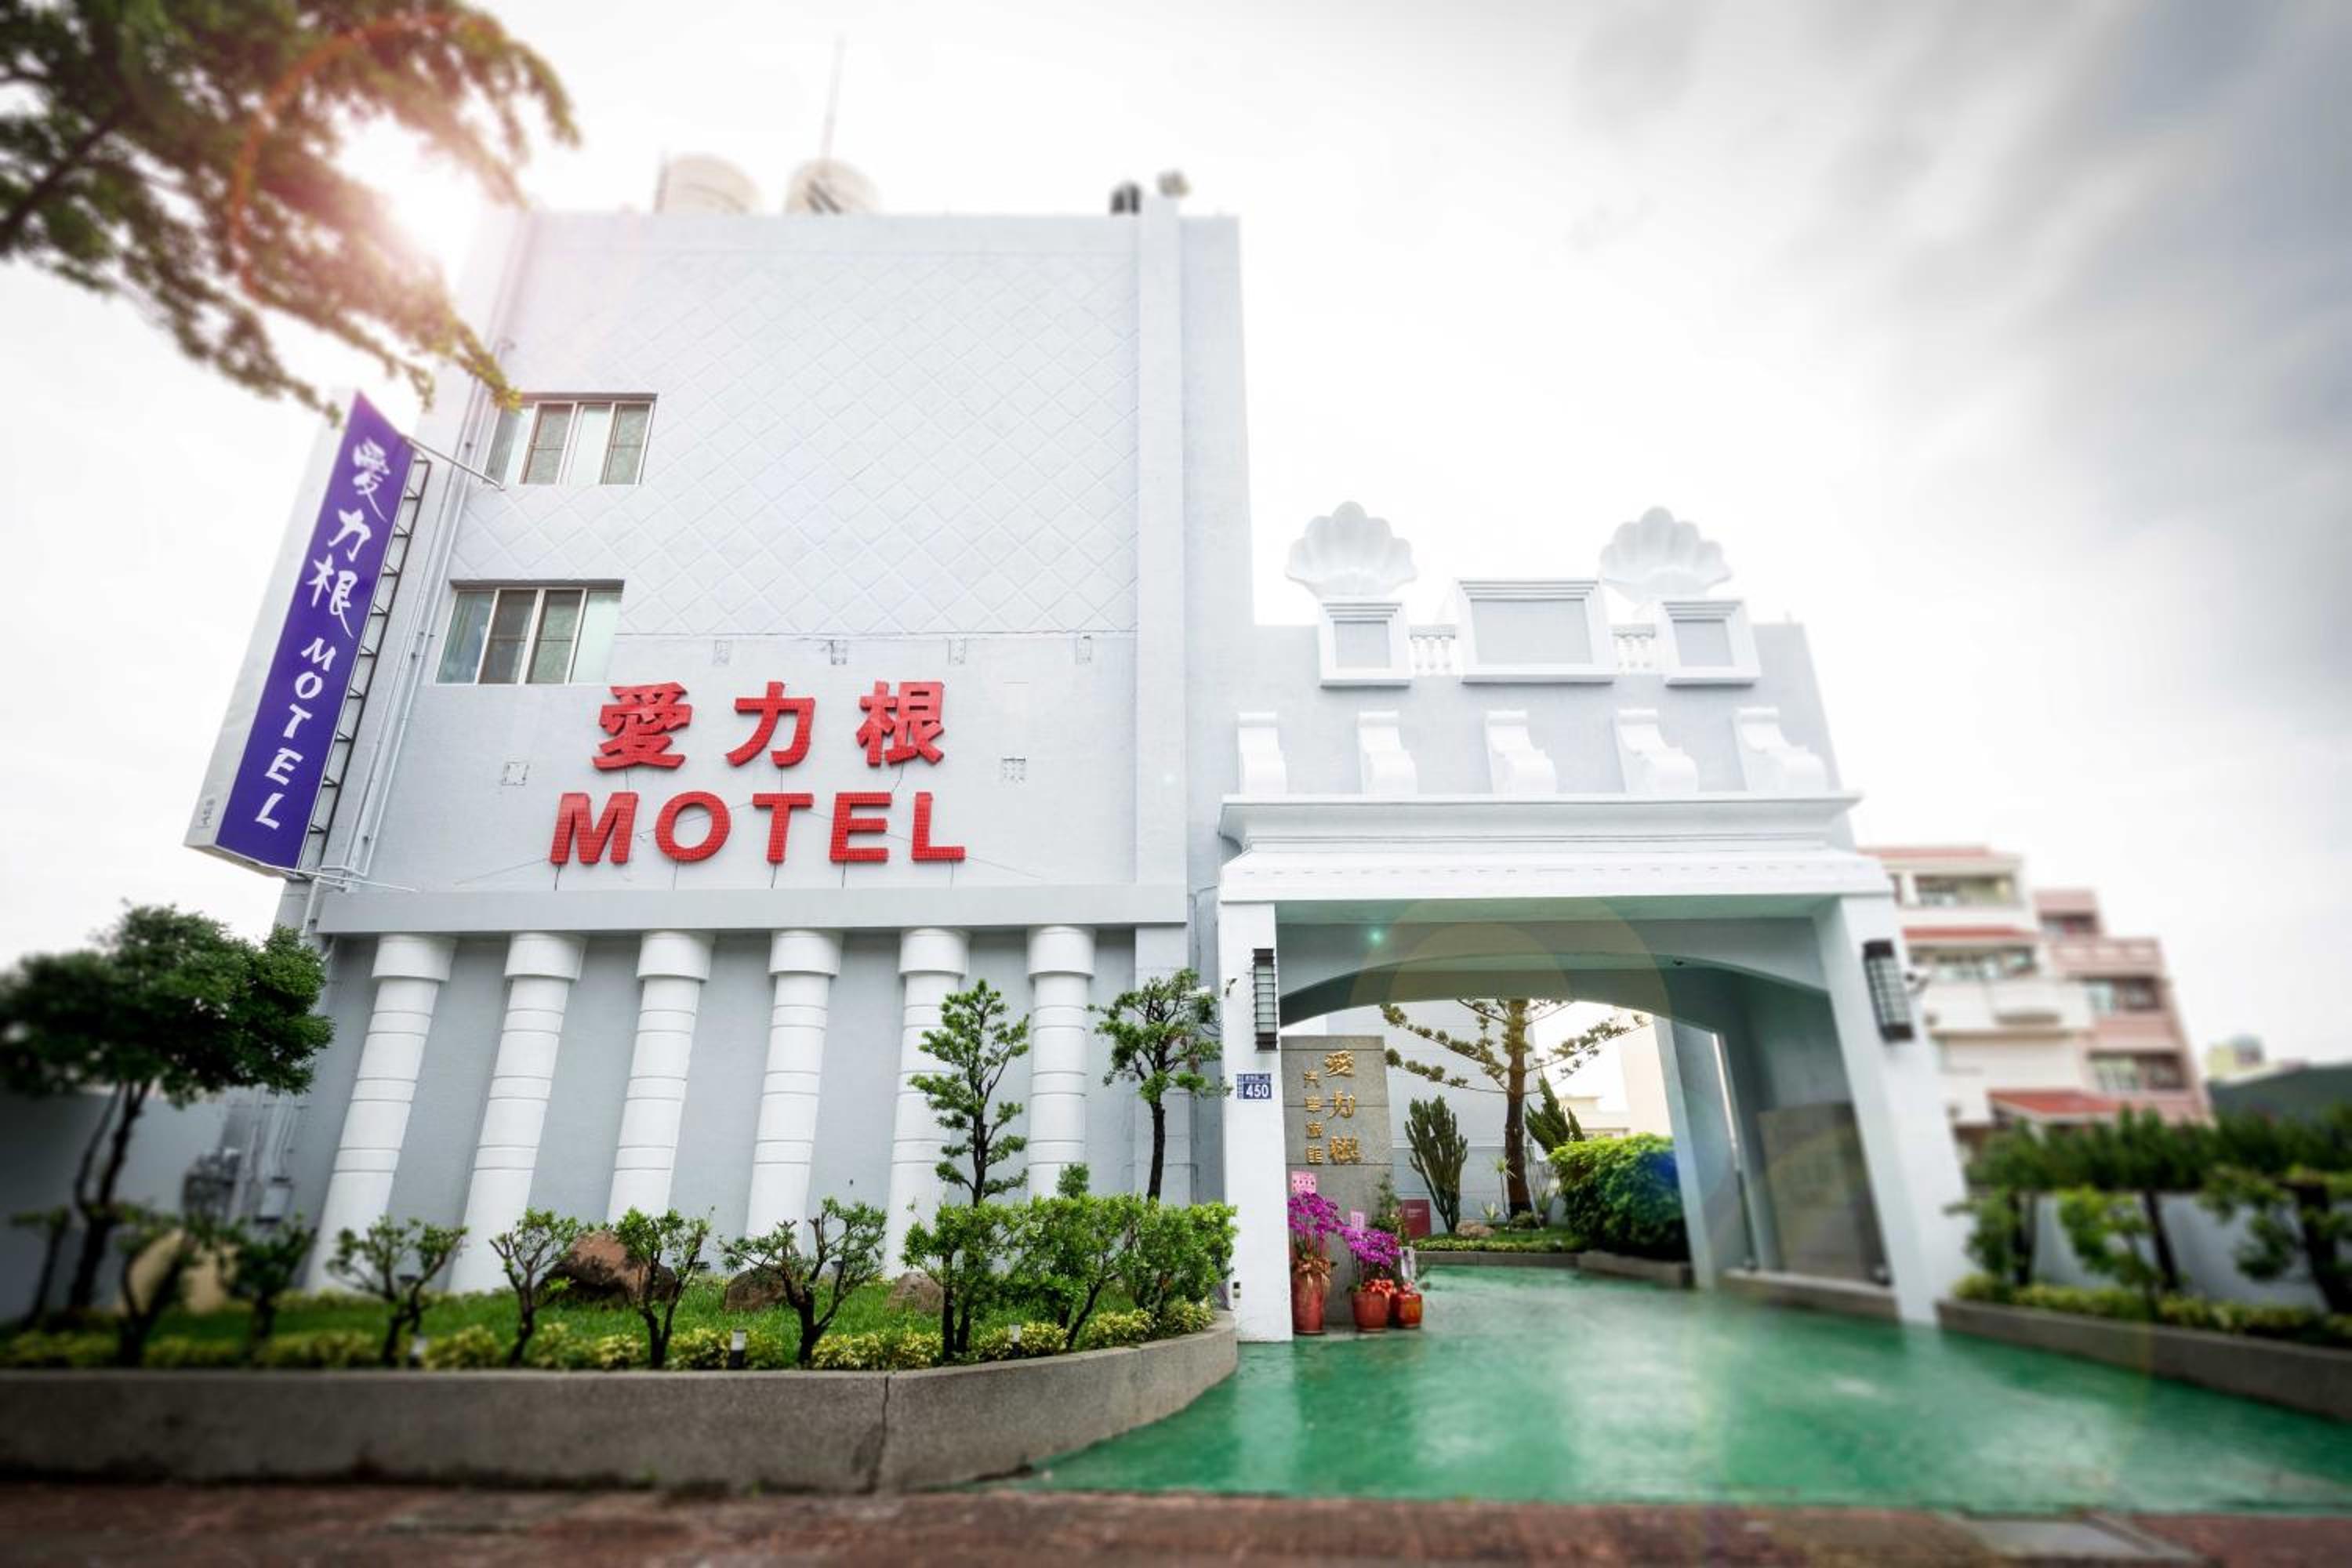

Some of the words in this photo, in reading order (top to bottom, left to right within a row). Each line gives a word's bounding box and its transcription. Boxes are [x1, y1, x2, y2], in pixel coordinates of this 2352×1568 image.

[307, 437, 390, 638] 愛力根
[255, 637, 336, 829] MOTEL
[592, 681, 945, 770] 愛力根
[550, 791, 967, 866] MOTEL
[1246, 1084, 1269, 1098] 450
